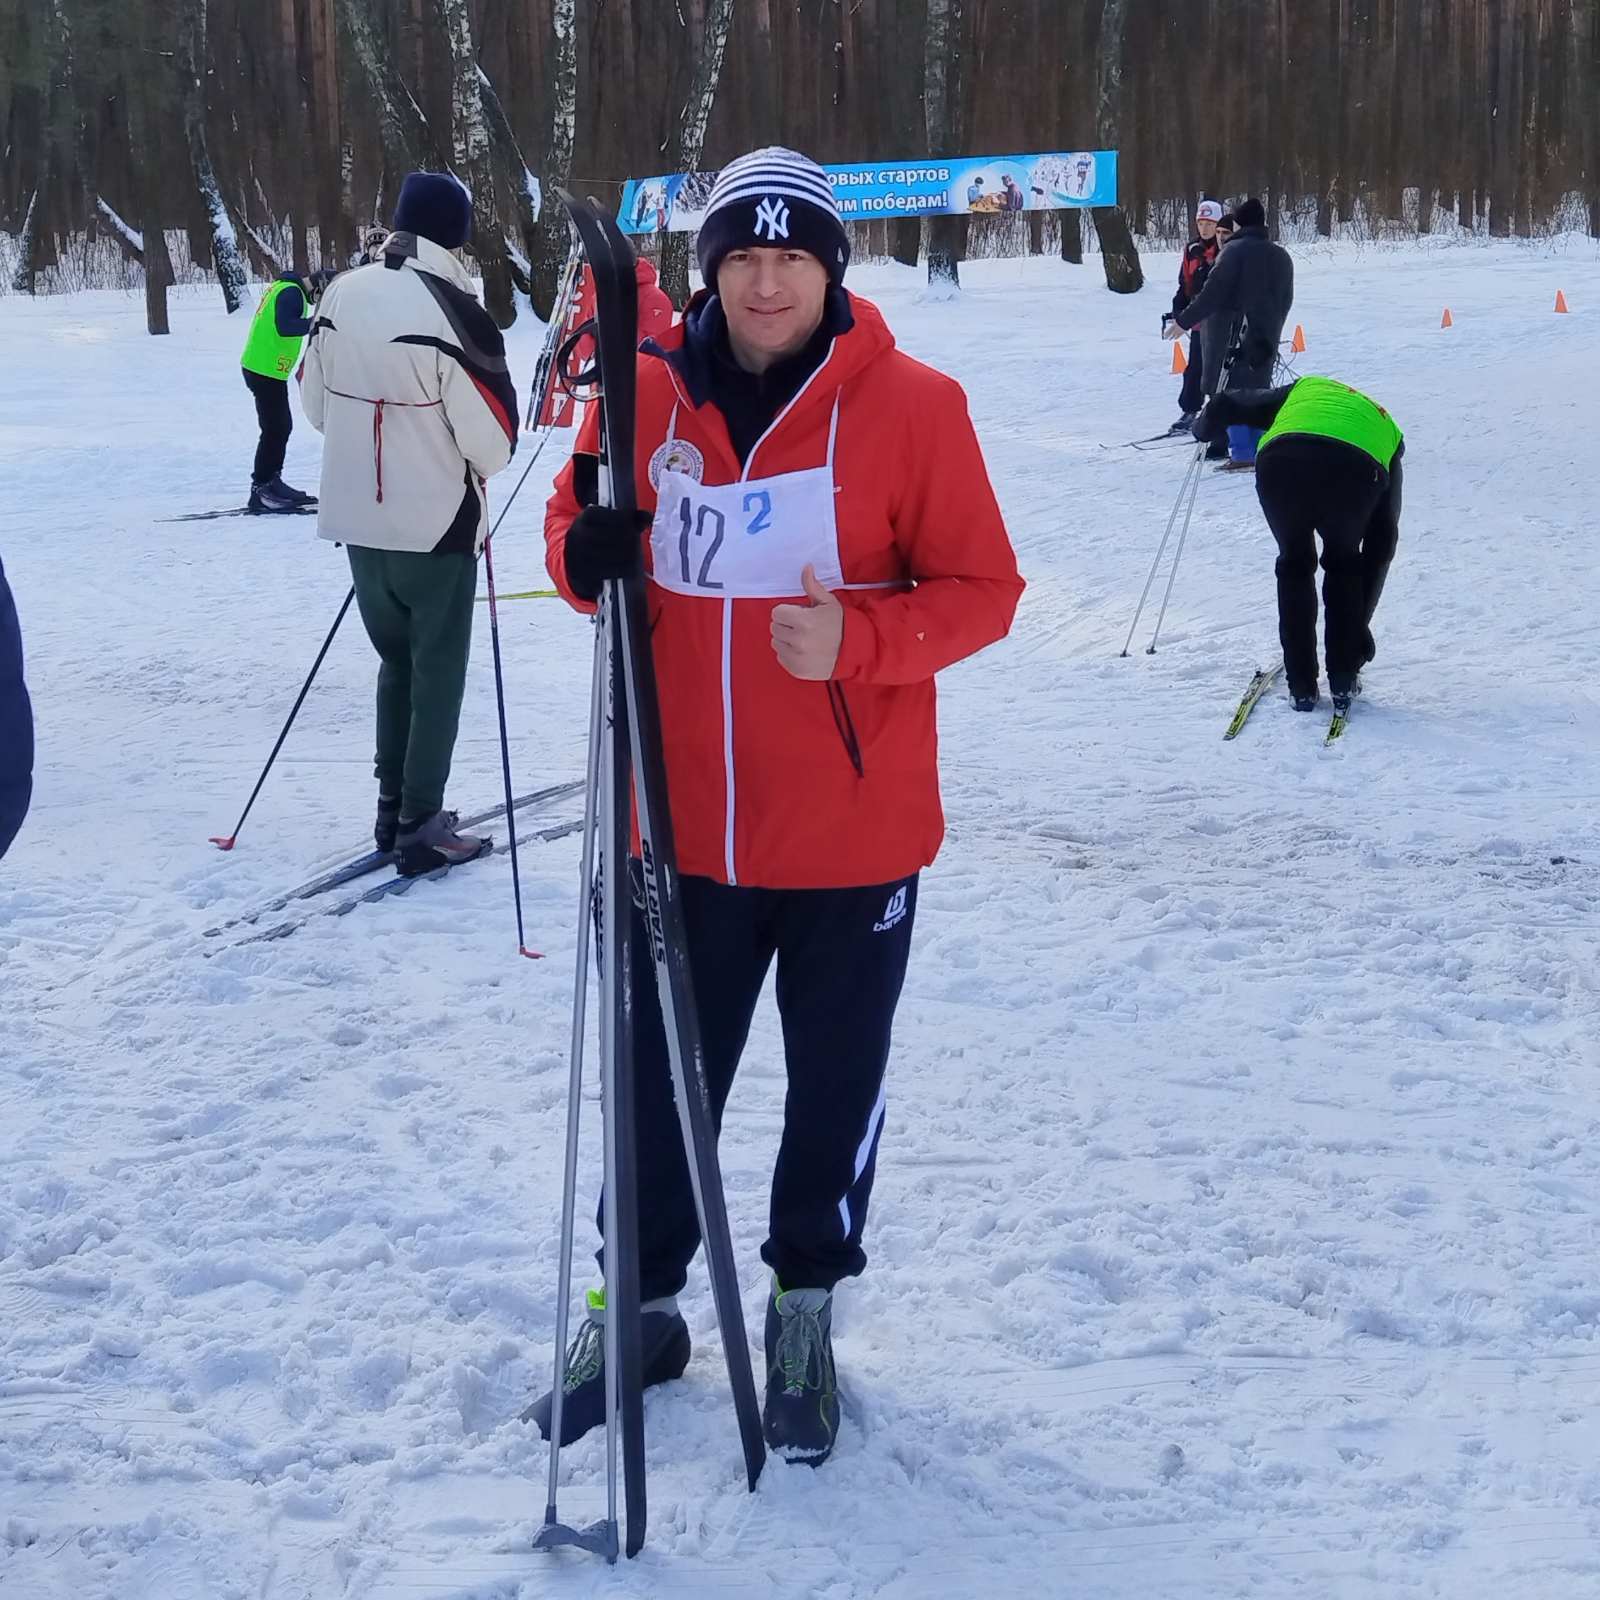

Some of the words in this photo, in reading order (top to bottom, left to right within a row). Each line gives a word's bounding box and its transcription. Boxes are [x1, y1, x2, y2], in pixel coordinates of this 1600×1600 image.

[828, 172, 874, 186] овых
[878, 168, 949, 186] стартов
[835, 198, 857, 212] им
[862, 191, 949, 212] победам!
[743, 491, 772, 535] 2
[679, 497, 725, 589] 12
